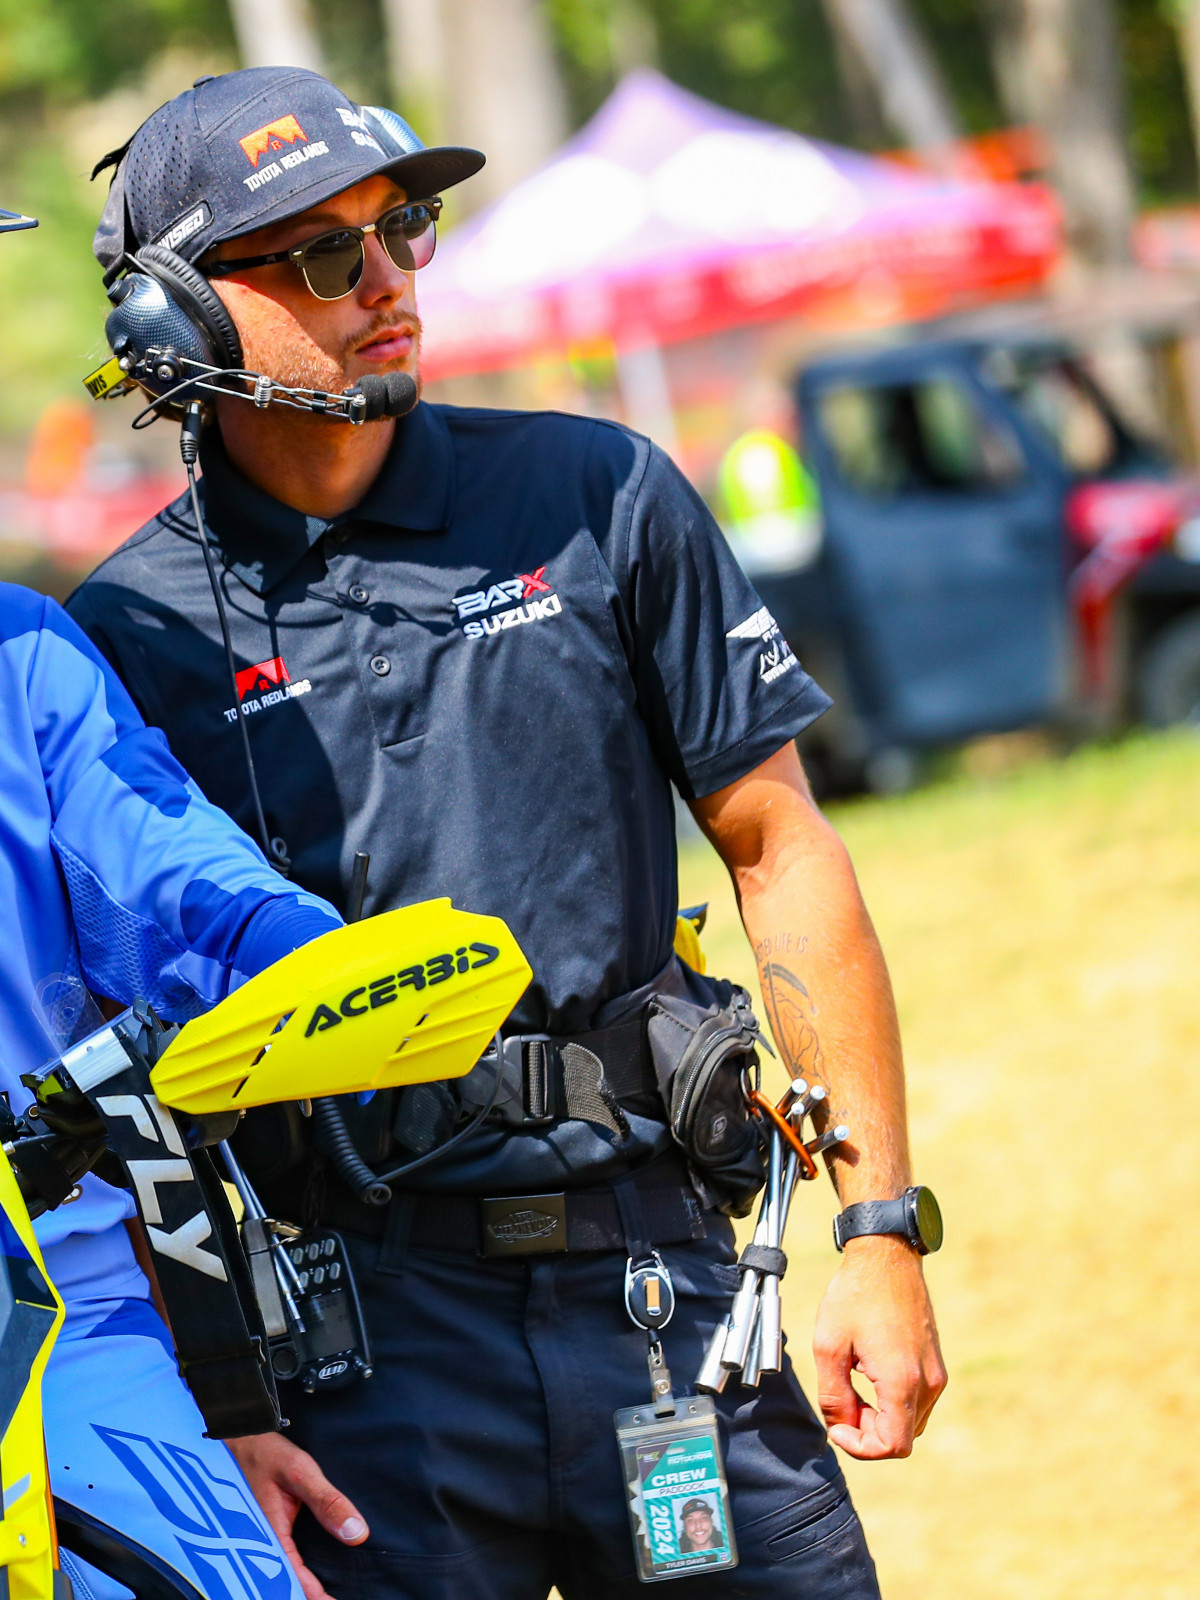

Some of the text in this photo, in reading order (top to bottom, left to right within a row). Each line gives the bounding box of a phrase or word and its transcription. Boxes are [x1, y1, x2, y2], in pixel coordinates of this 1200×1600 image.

[243, 140, 330, 192] TOYOTA REDLANDS
[156, 208, 204, 251] WISTED
[452, 566, 551, 619] BARX
[463, 594, 562, 641] SUZUKI
[224, 678, 312, 723] TOOTA REDLANDS
[258, 679, 271, 691] R
[304, 941, 500, 1039] ACERBIS
[96, 1093, 229, 1283] FLY
[651, 1467, 707, 1488] CREW
[659, 1481, 705, 1496] PADDOCK
[649, 1504, 676, 1556] 2024
[665, 1556, 707, 1570] TYLER DAVIS
